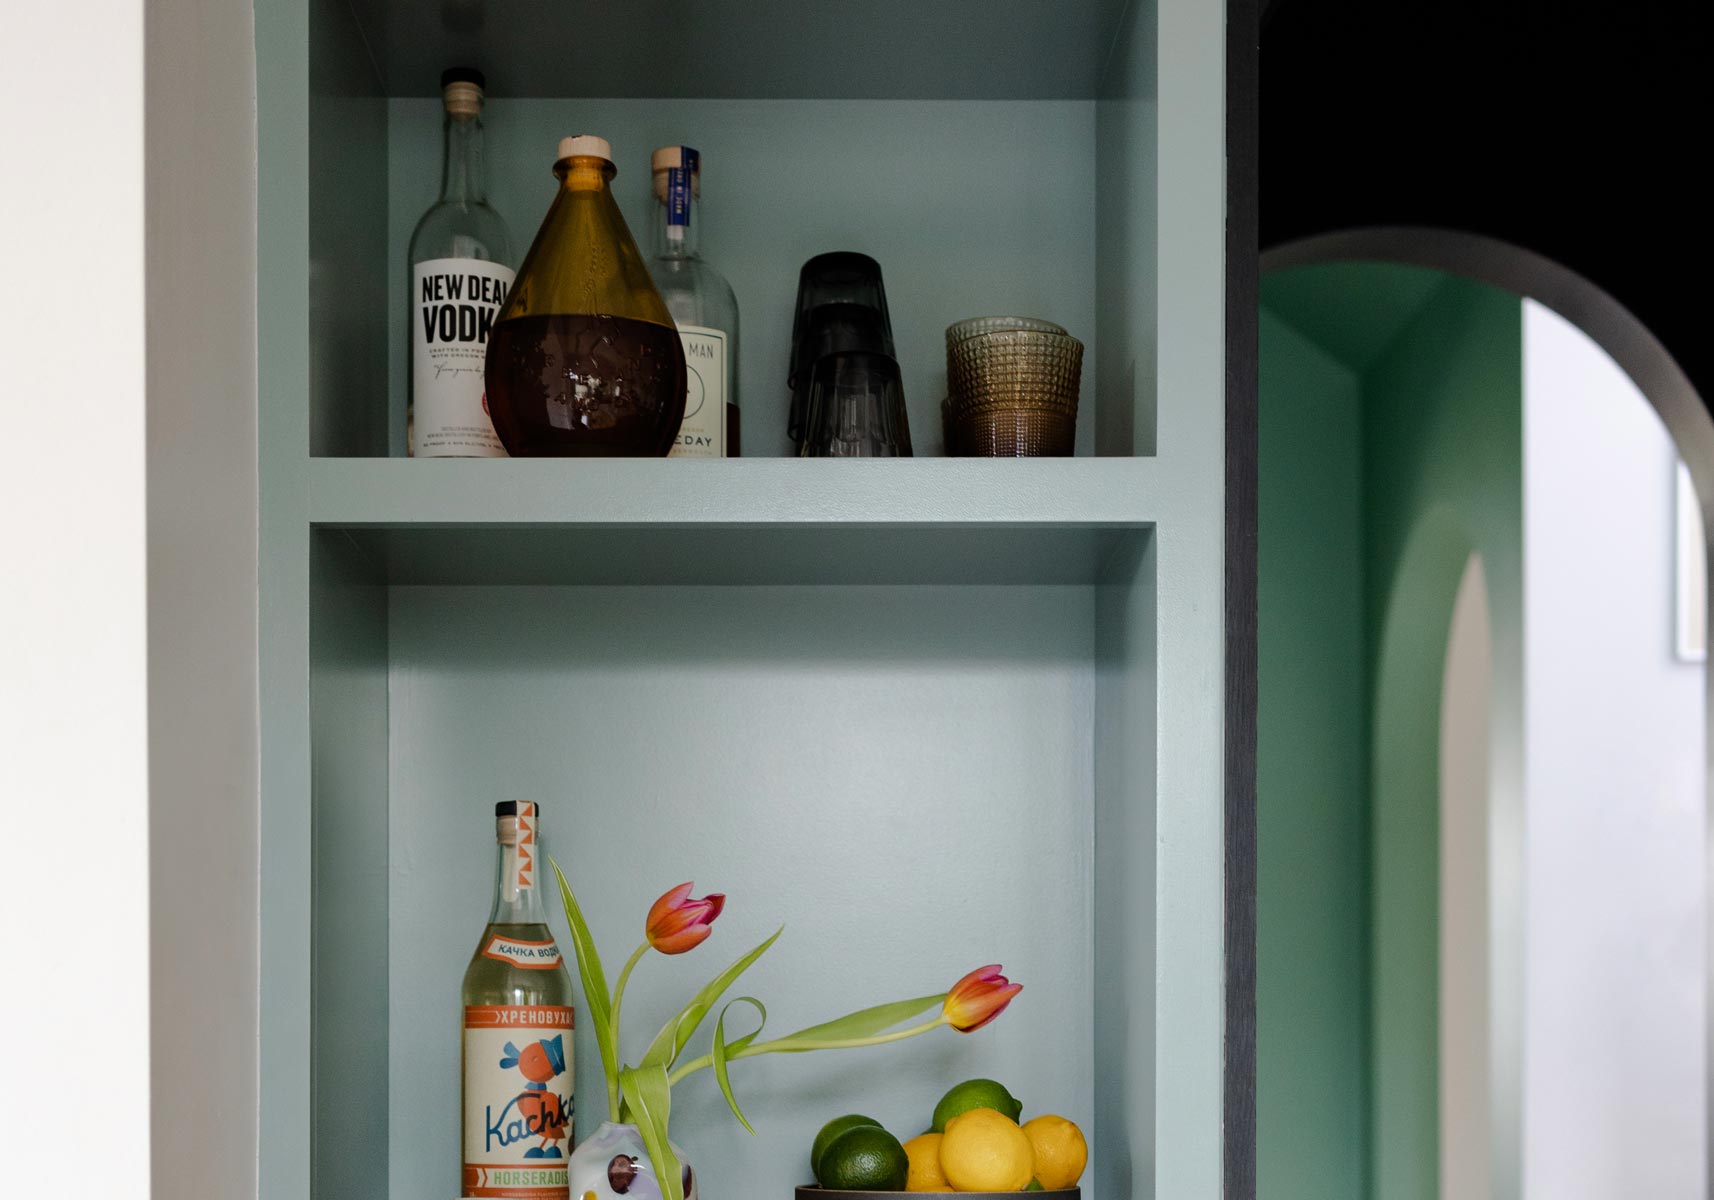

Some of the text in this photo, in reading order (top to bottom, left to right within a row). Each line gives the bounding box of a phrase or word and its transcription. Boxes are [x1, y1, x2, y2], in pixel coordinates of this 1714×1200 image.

[422, 274, 463, 303] NEW
[423, 304, 494, 344] VODK
[689, 342, 714, 359] MAN
[498, 944, 535, 958] КАЧКА
[486, 1093, 575, 1153] Kachka
[494, 1170, 569, 1186] HORSERADIS
